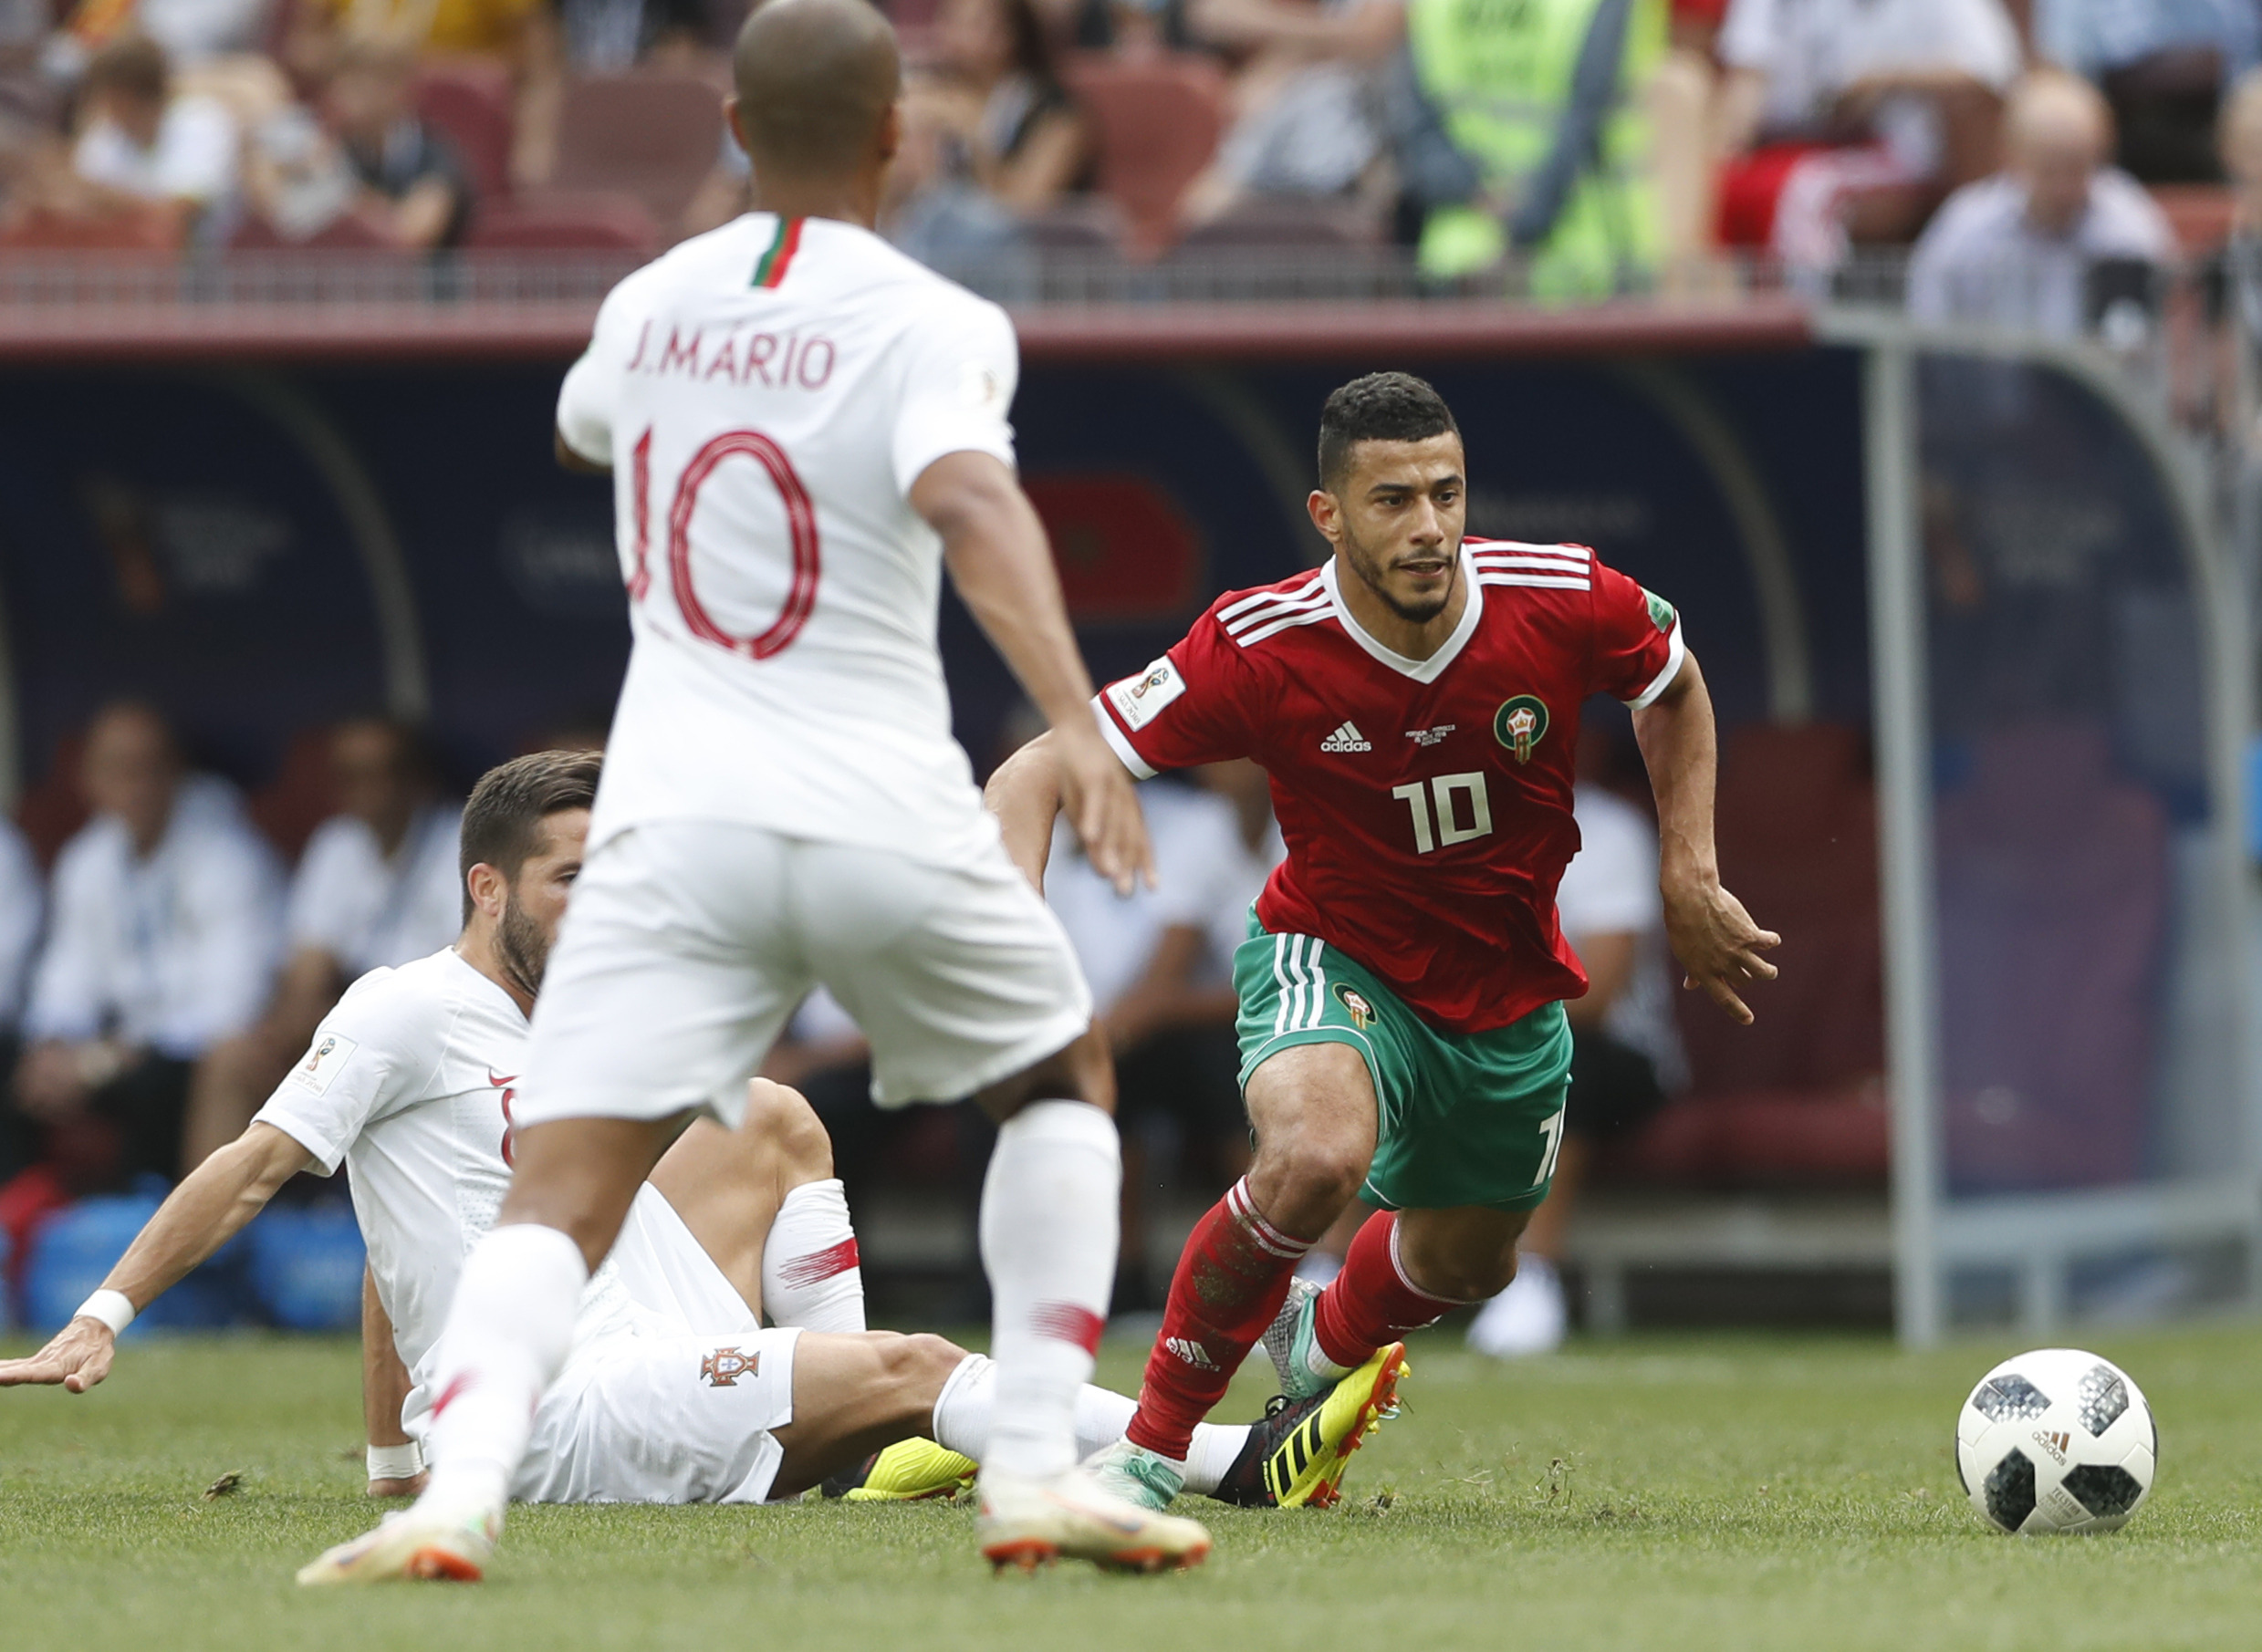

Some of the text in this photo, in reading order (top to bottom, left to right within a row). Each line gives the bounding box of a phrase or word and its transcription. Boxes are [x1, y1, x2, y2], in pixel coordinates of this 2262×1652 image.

[627, 424, 823, 662] 10
[1320, 740, 1371, 753] adidas
[1392, 771, 1493, 855] 10
[2031, 1431, 2067, 1467] adidas
